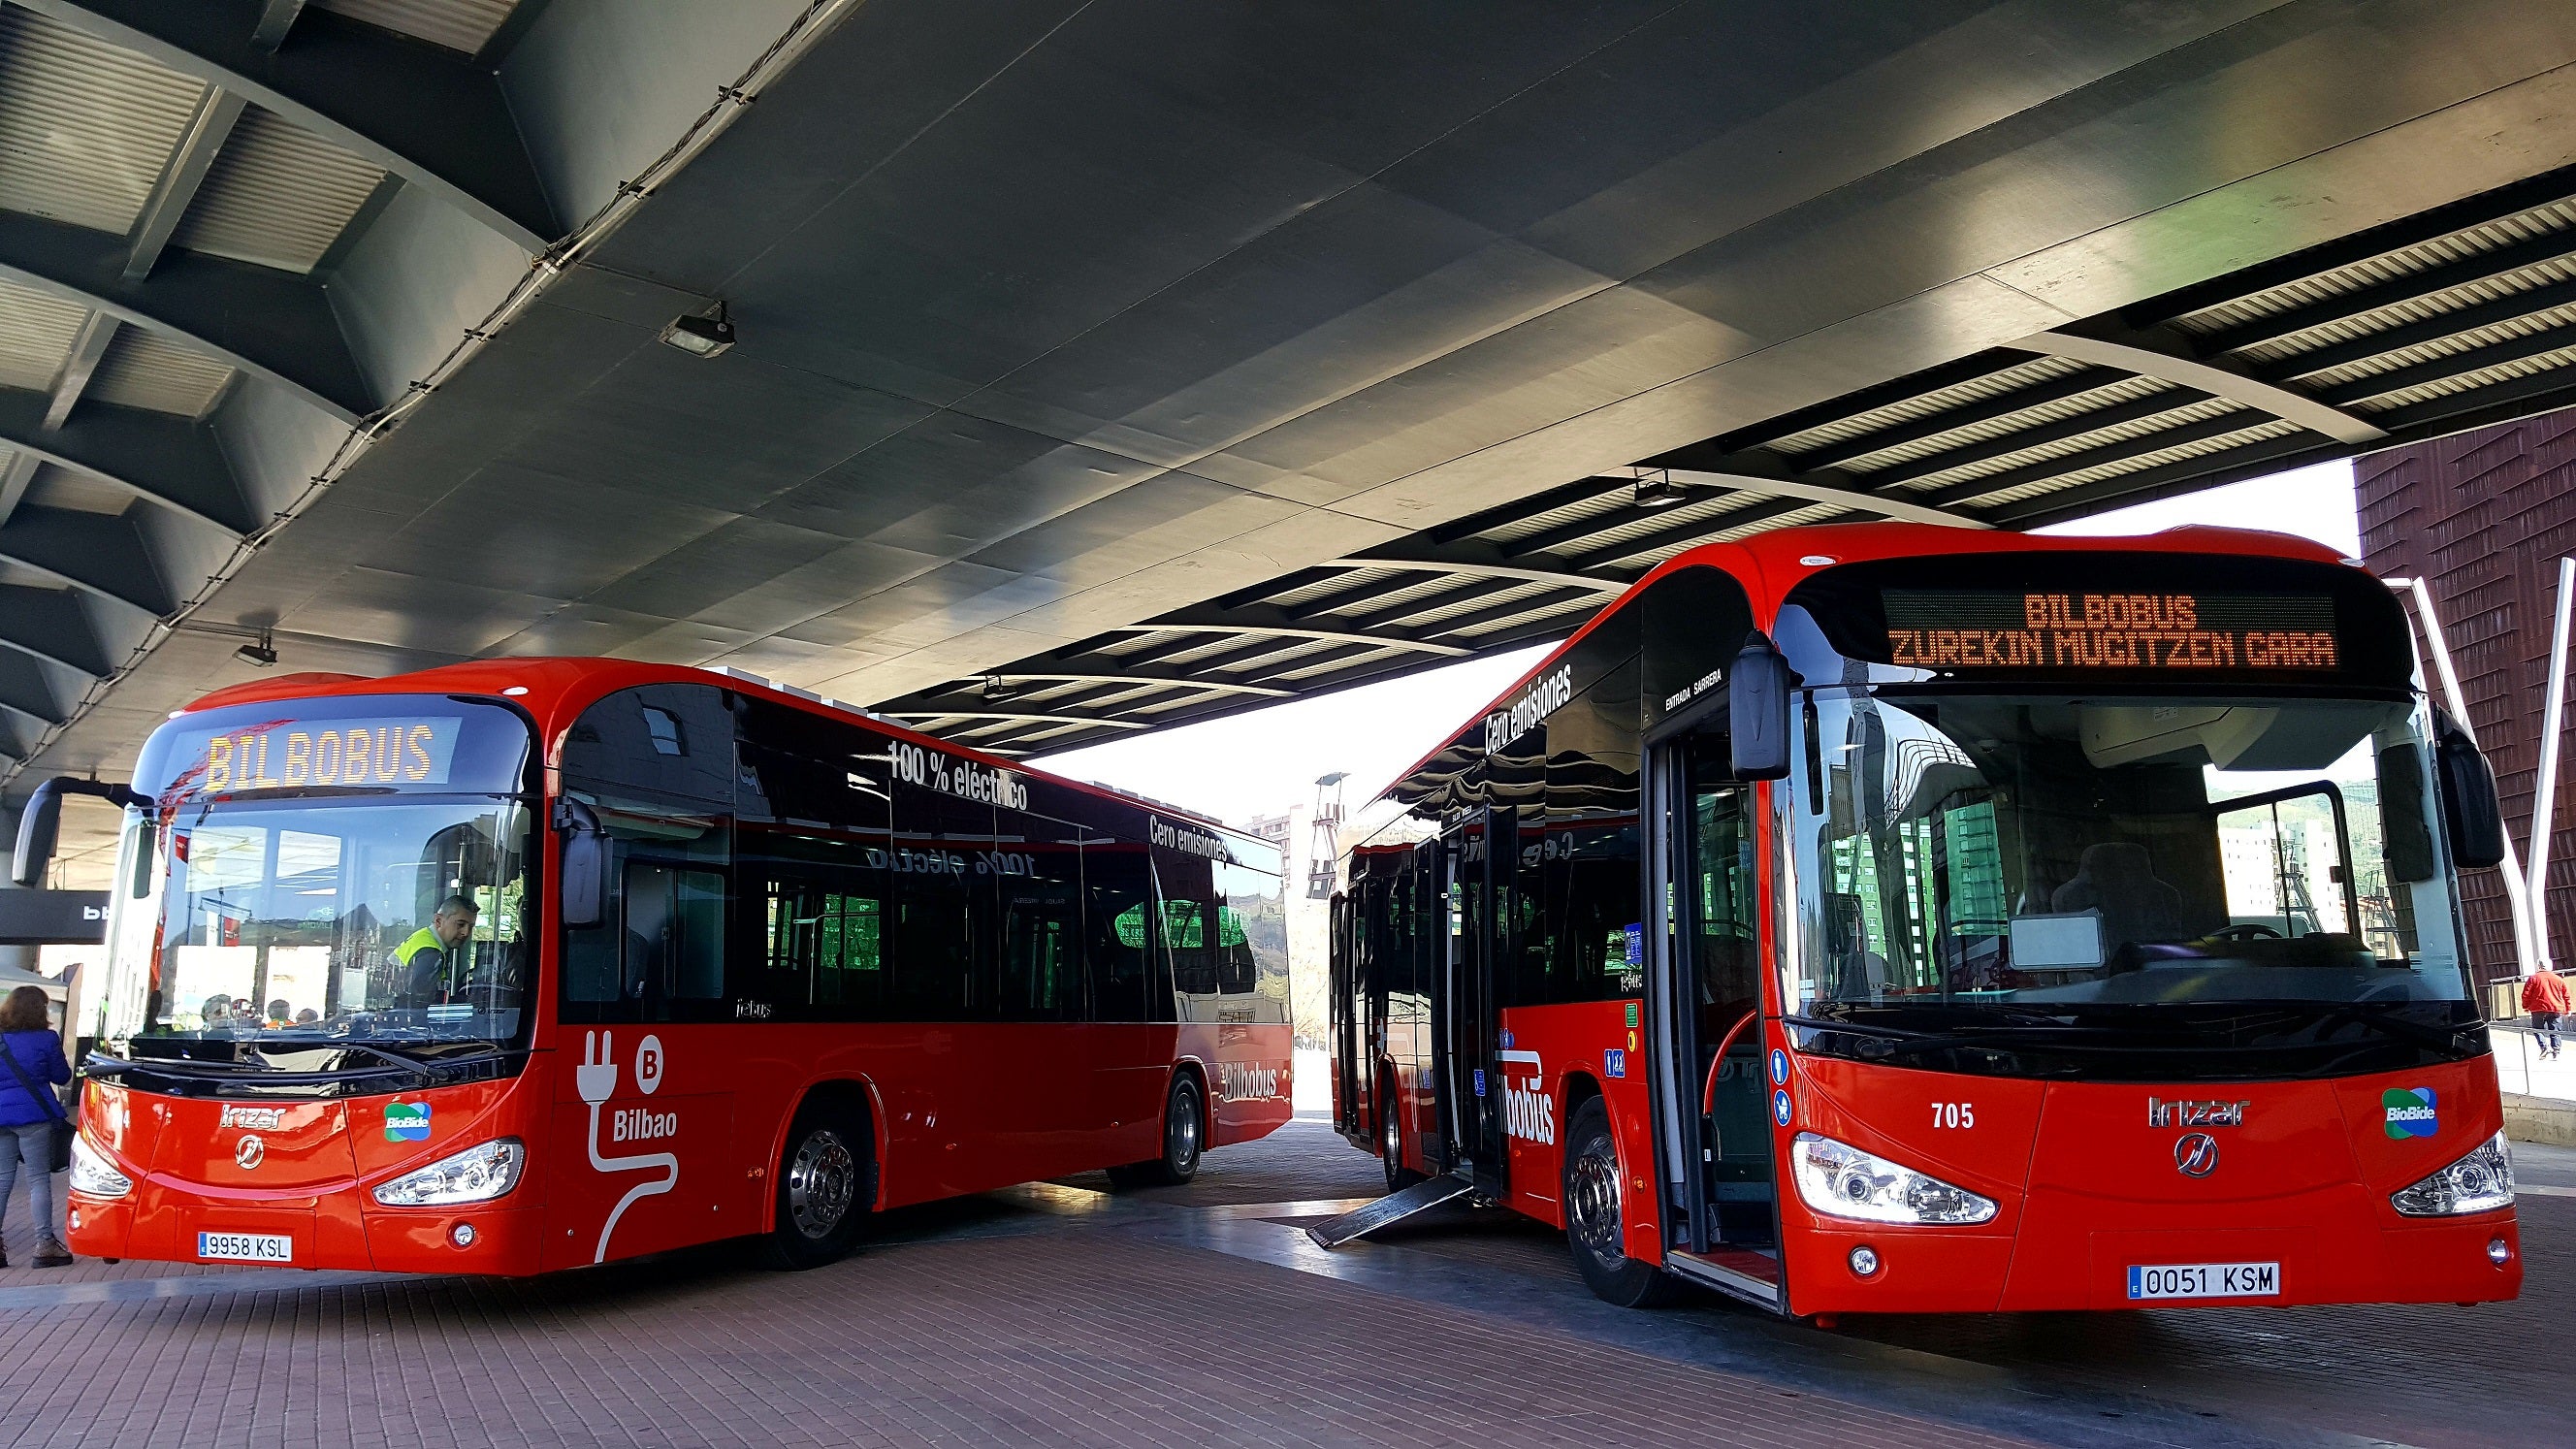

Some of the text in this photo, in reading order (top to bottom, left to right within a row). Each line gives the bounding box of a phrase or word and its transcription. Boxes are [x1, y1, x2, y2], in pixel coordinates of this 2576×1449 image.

[2025, 595, 2197, 629] BILBOBUS
[1888, 630, 2336, 666] ZUREKIN MUGITZEN GARA
[1665, 667, 1722, 712] ENTRADA SARRERA
[1485, 663, 1571, 757] Cero emisiones
[202, 724, 434, 793] BILBOBUS
[887, 740, 1028, 811] 100 % eléctrico
[1149, 814, 1228, 862] Cero emisiones
[642, 1049, 658, 1080] B
[1225, 1062, 1277, 1100] Bilbobus
[386, 1116, 429, 1129] BioBide
[613, 1108, 677, 1142] Bilbao
[1931, 1102, 1975, 1129] 705
[2386, 1106, 2435, 1122] BioBide
[209, 1236, 250, 1256] 9958
[256, 1238, 288, 1258] KSL
[2146, 1268, 2206, 1294] 0051
[2223, 1266, 2273, 1293] KSM
